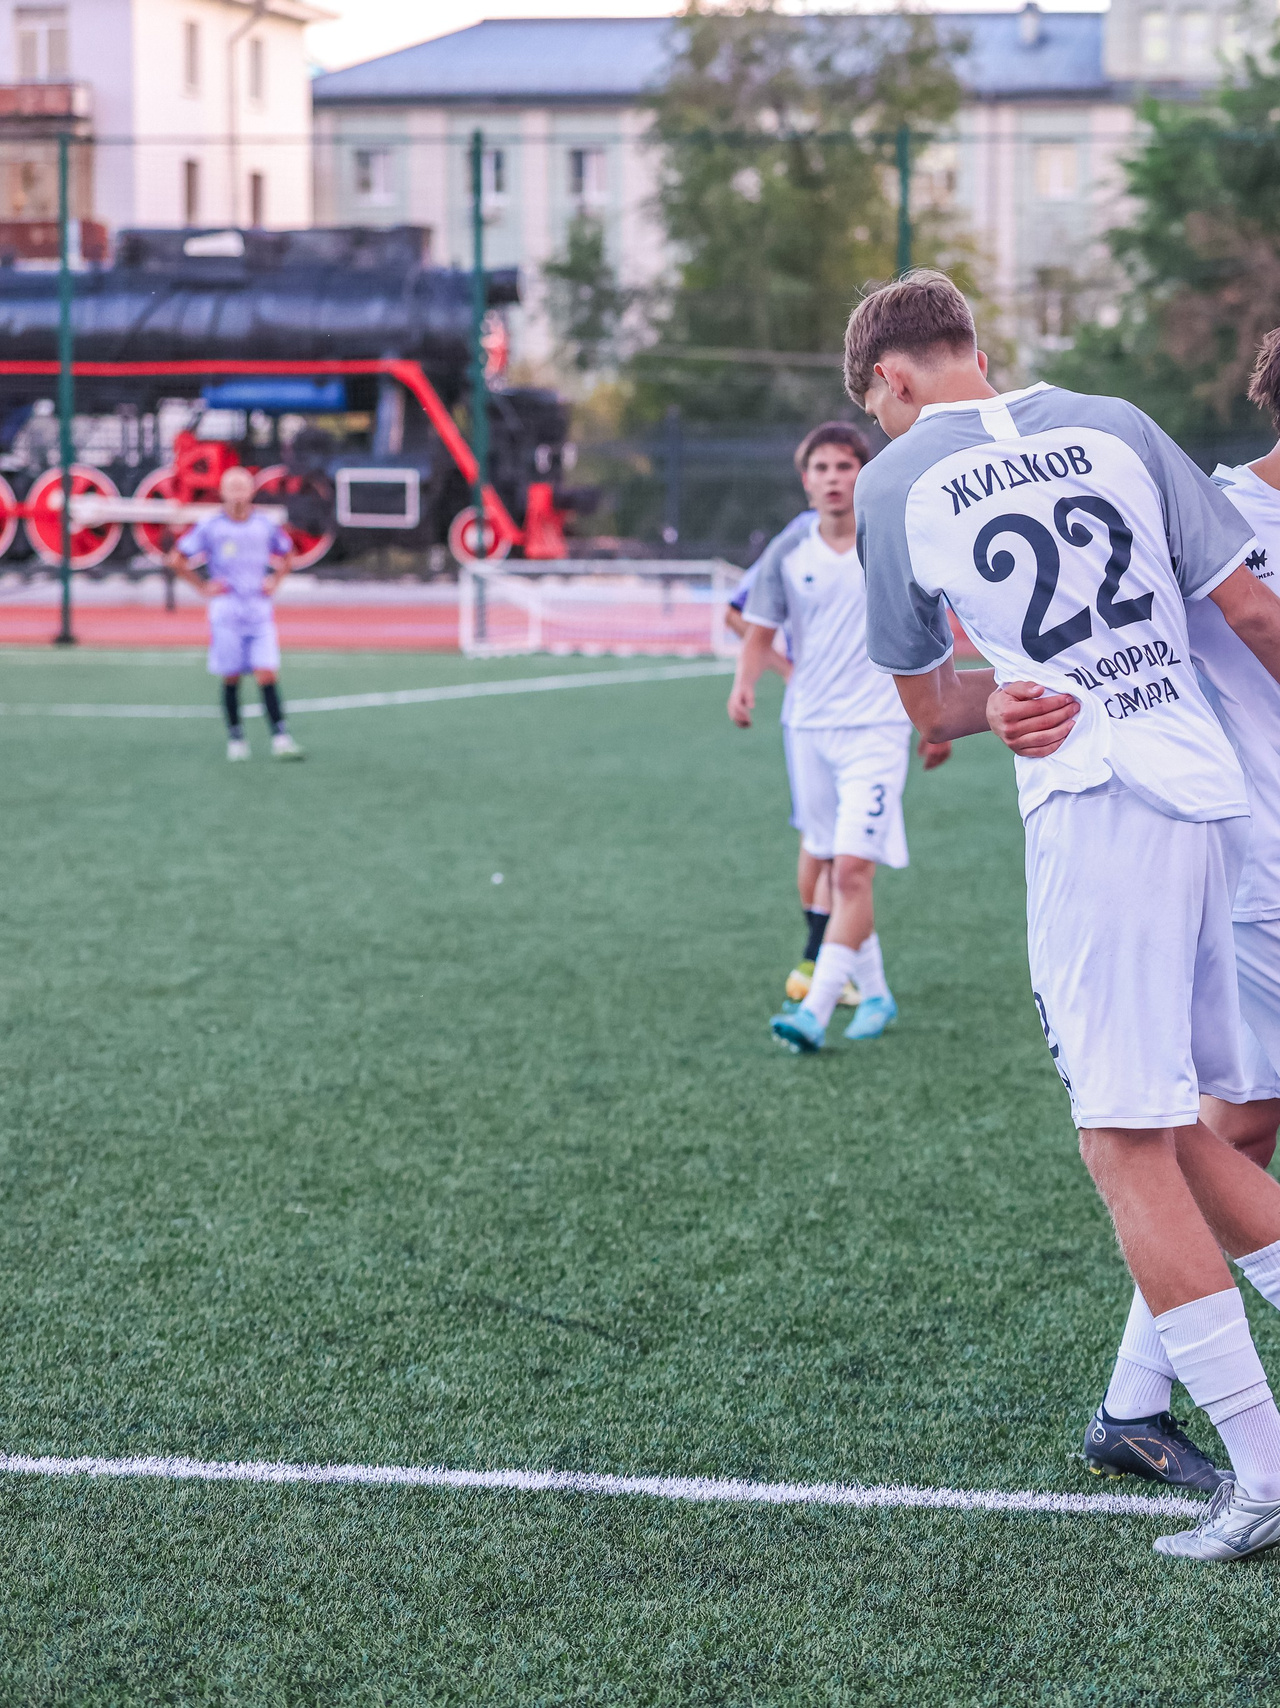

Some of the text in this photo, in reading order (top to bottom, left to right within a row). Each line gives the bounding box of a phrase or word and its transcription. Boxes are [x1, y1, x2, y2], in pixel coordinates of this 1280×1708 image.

[941, 445, 1092, 516] ЖИДКОВ
[973, 495, 1155, 664] 22
[867, 783, 886, 817] 3
